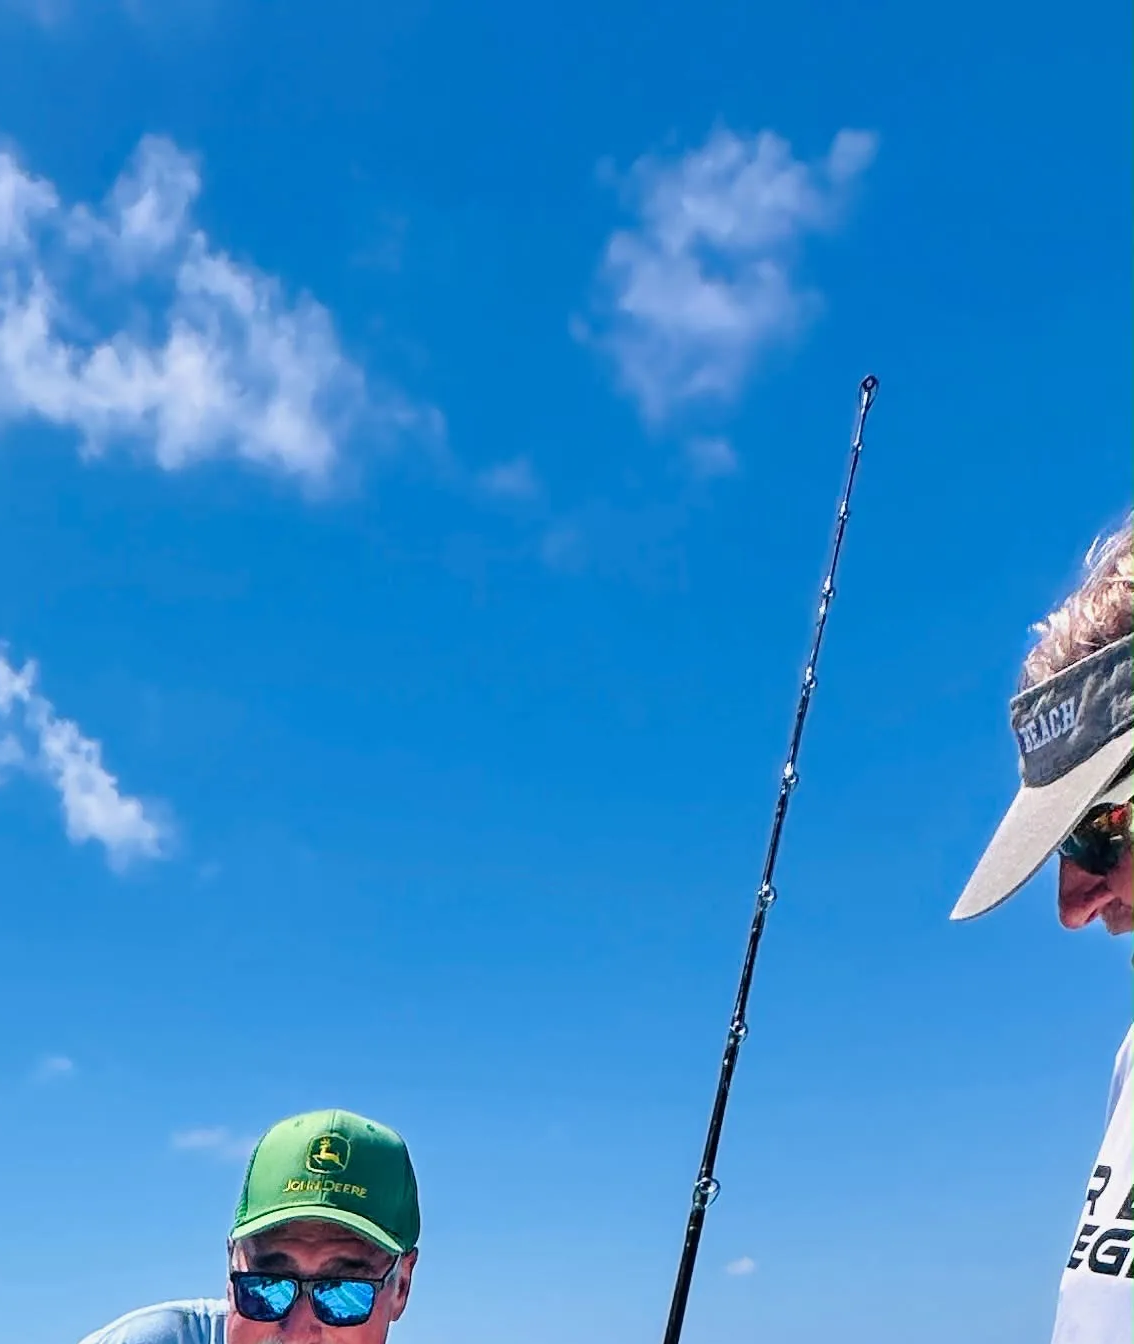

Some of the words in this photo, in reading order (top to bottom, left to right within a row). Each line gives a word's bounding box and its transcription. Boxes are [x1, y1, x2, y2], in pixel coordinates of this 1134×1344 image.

[1019, 696, 1076, 754] BEACH
[322, 1180, 368, 1199] DEERE
[1067, 1223, 1134, 1279] EG
